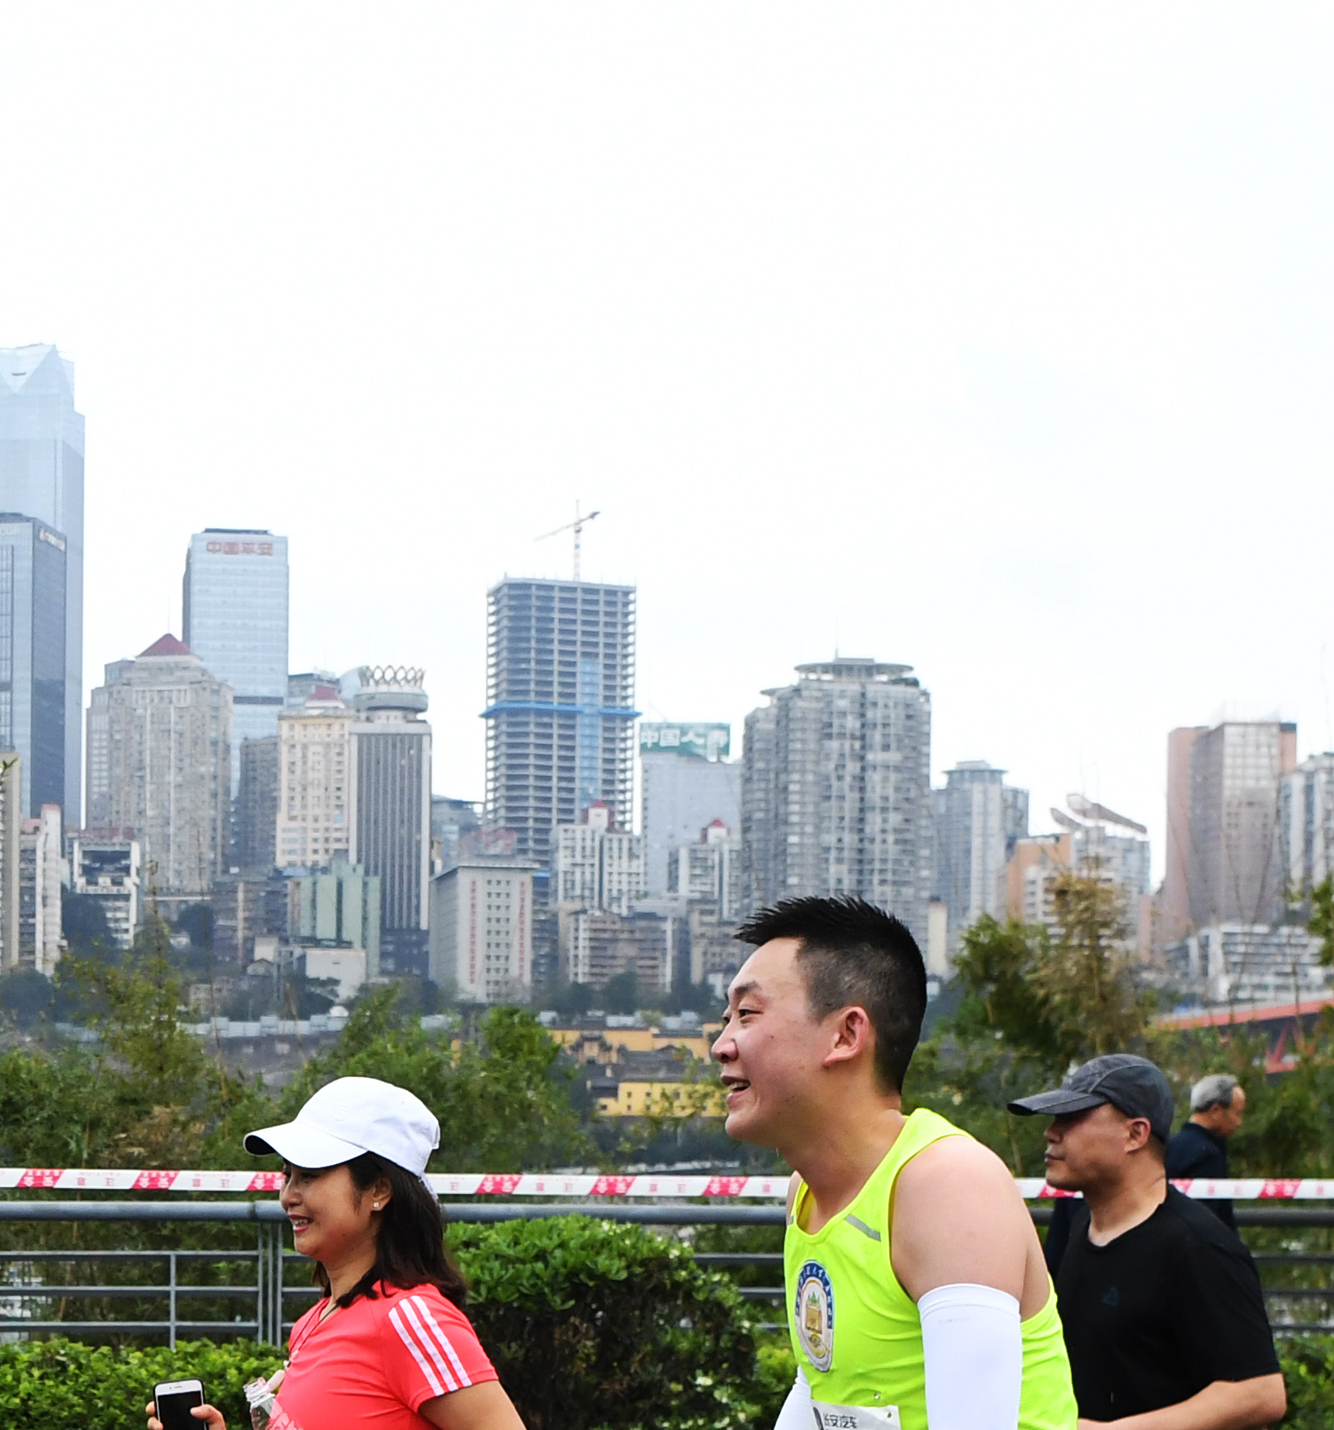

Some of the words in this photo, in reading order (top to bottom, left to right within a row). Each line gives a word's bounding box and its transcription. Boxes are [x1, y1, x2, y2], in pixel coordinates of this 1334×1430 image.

[206, 541, 273, 557] 中国平安
[823, 1413, 857, 1429] 长安汽车
